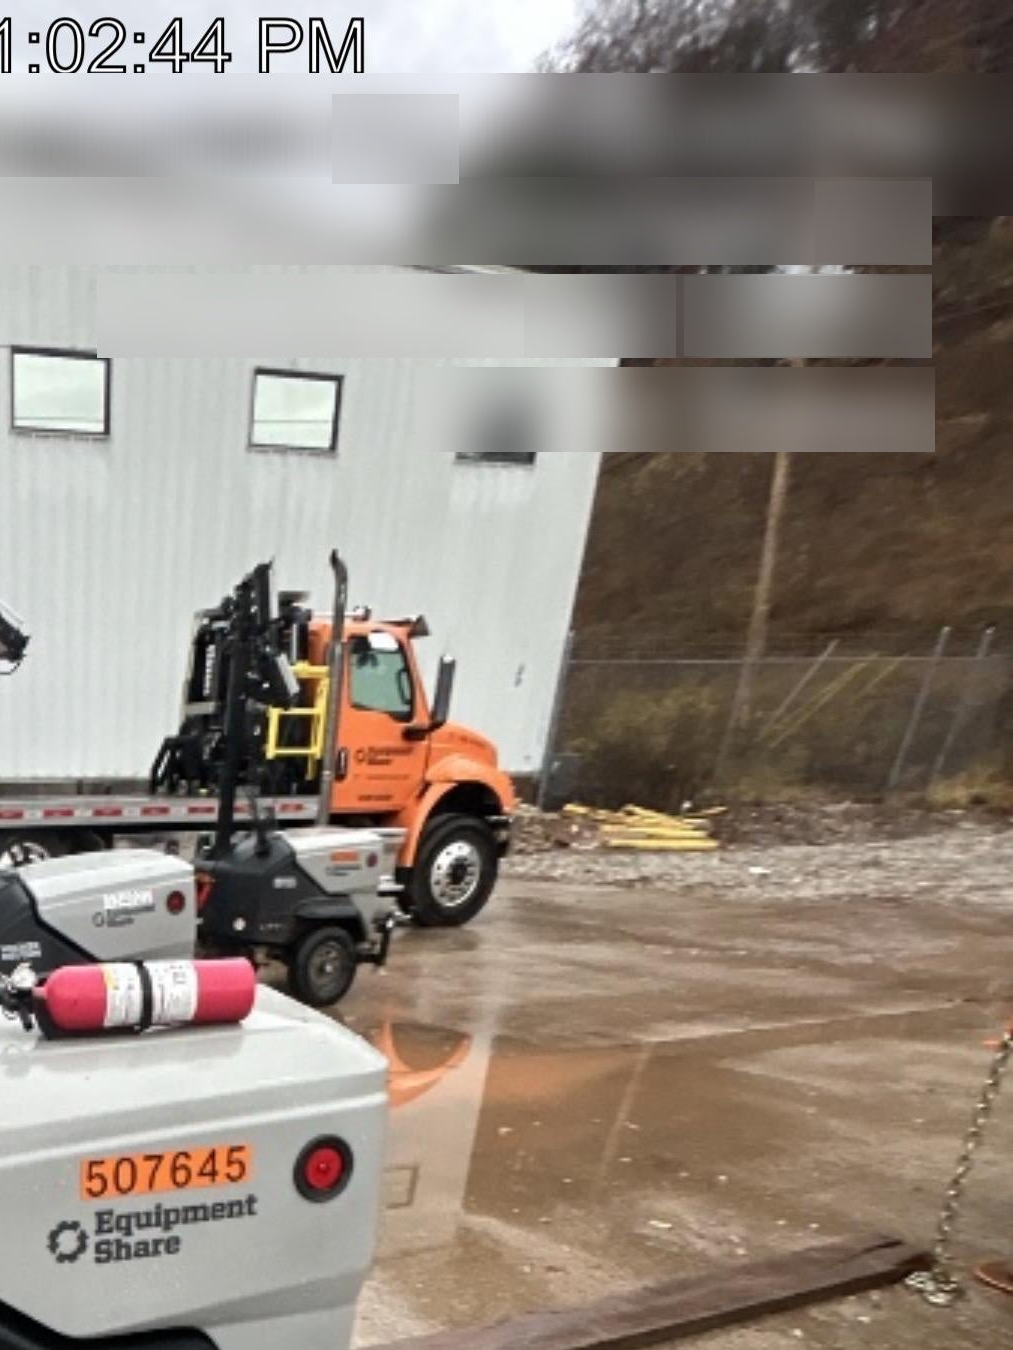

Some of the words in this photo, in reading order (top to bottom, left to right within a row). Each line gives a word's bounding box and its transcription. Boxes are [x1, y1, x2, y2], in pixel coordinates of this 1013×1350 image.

[84, 1145, 247, 1198] 507645
[94, 1194, 258, 1235] Equipment
[94, 1234, 181, 1264] Share
